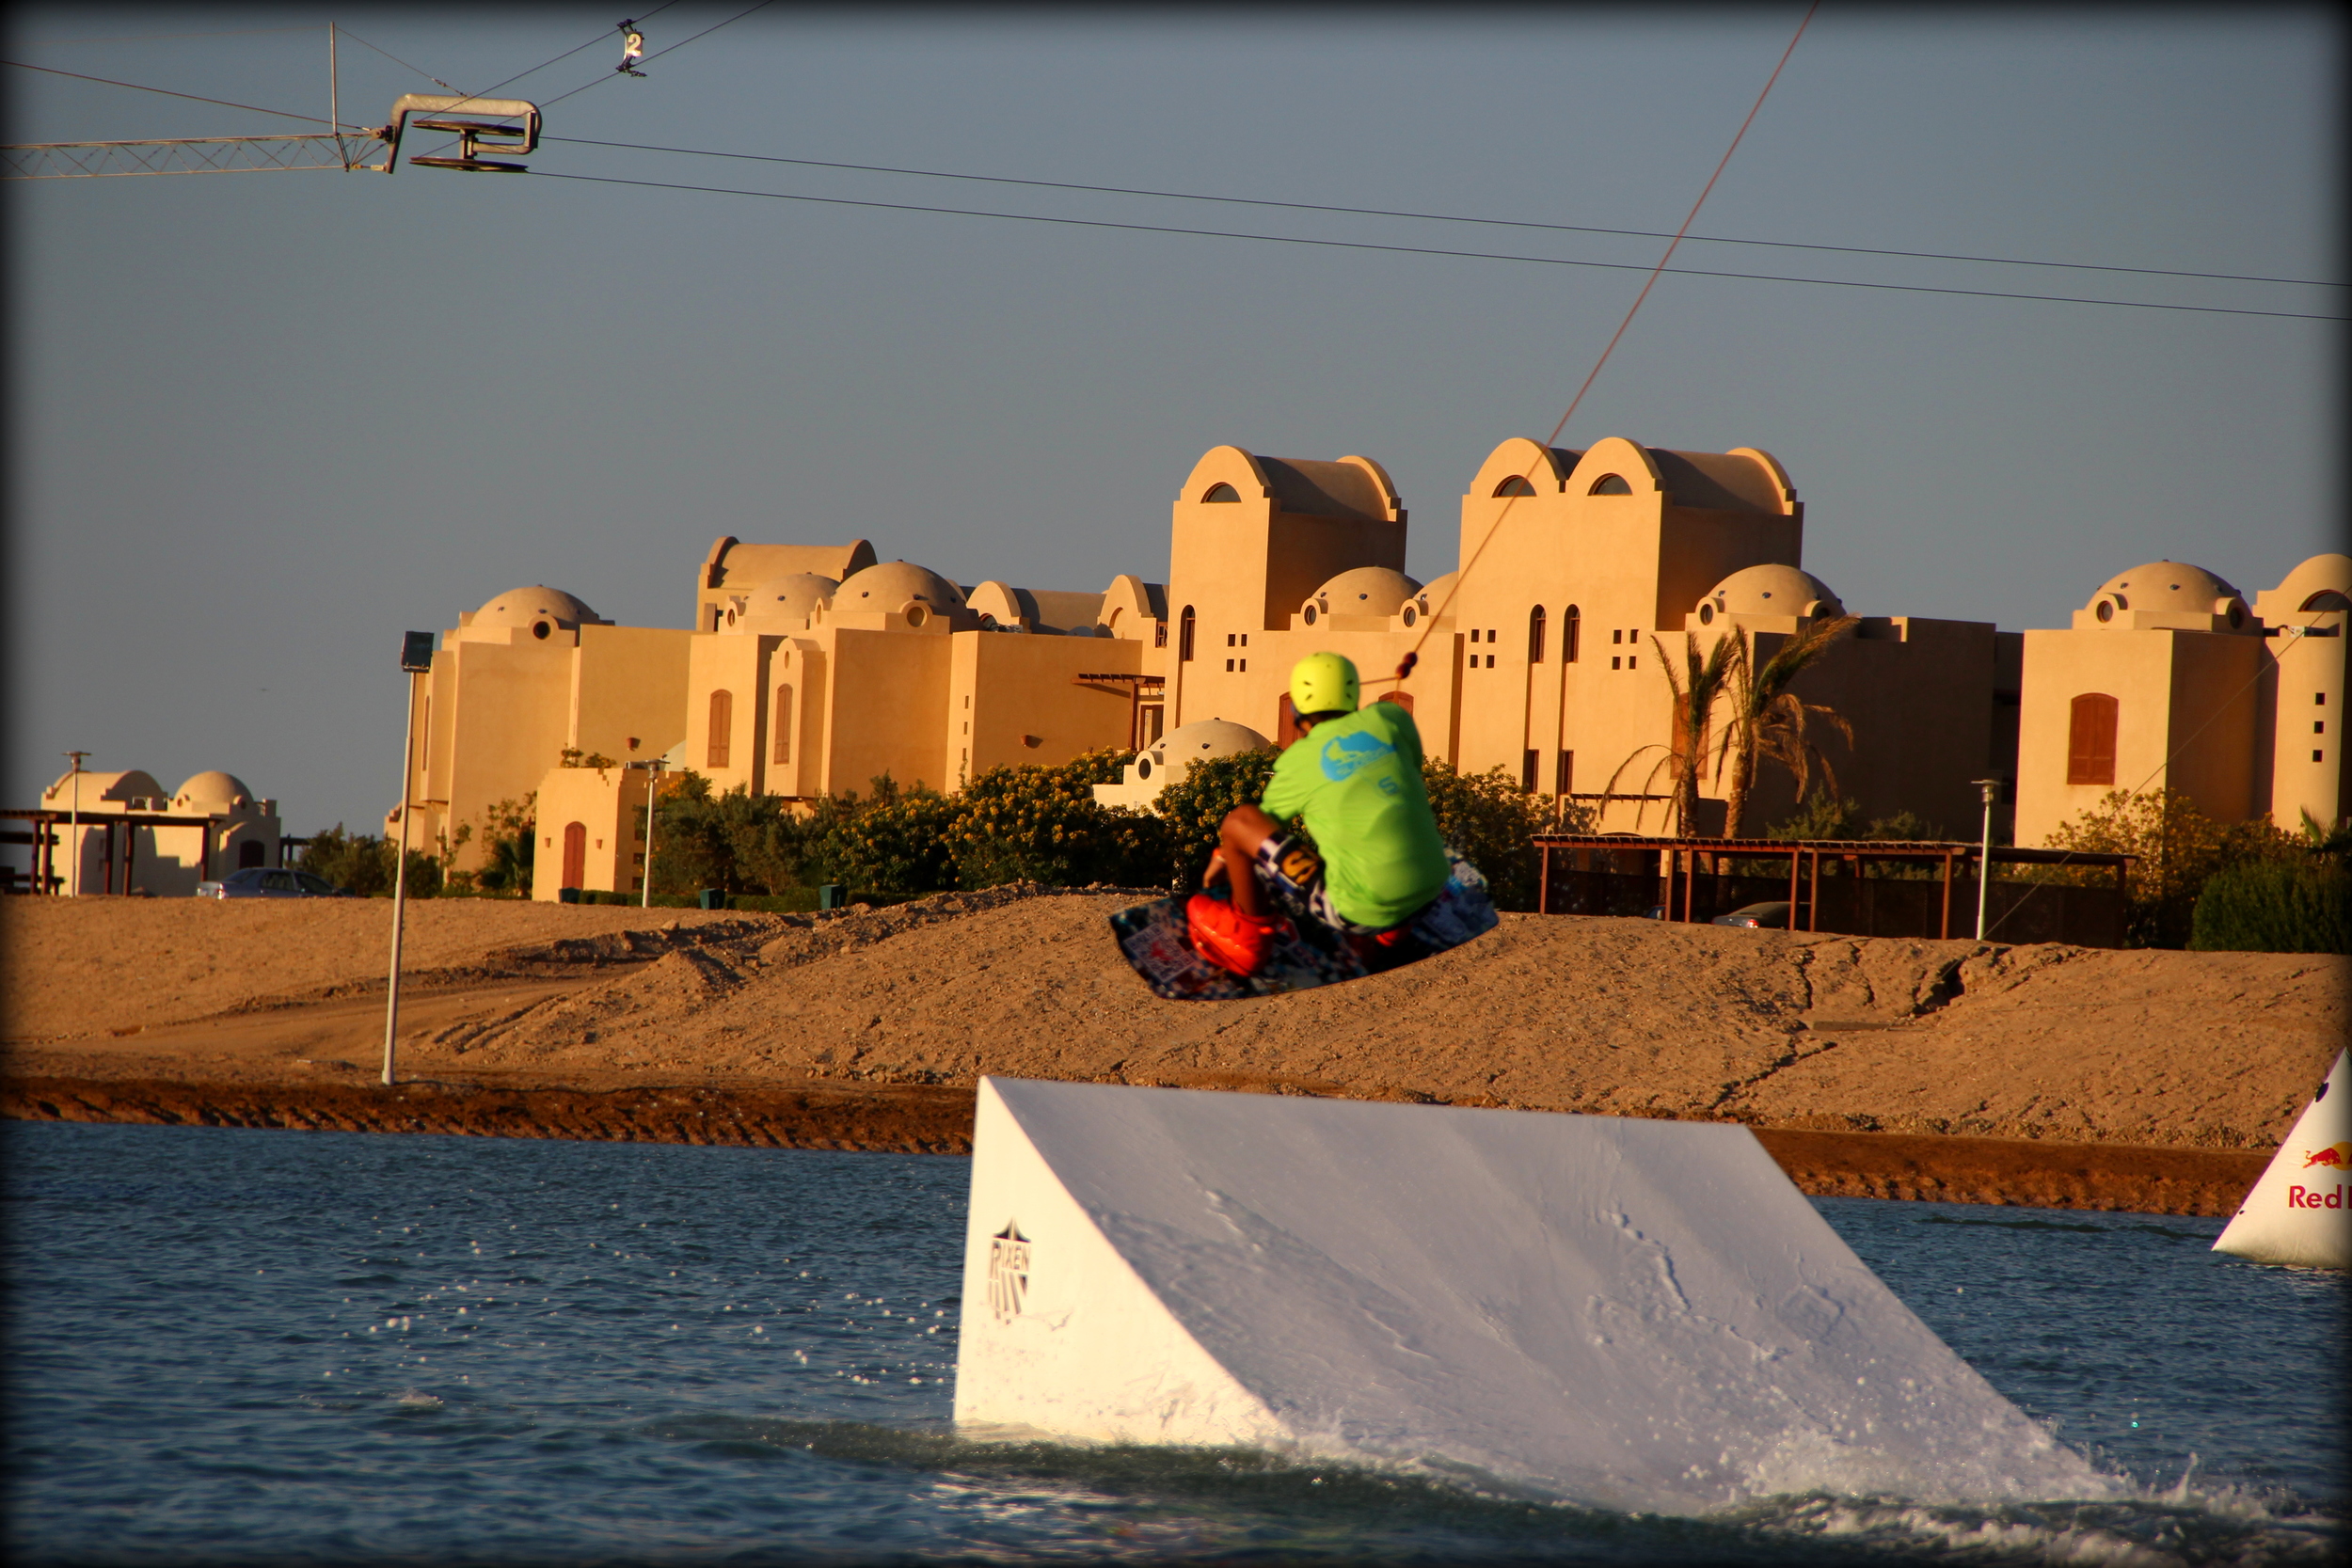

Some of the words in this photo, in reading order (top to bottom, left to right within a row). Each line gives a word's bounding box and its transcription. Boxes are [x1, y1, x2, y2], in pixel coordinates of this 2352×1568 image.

[627, 33, 642, 56] 2
[2289, 1184, 2343, 1209] Red
[989, 1239, 1031, 1280] RIXEN
